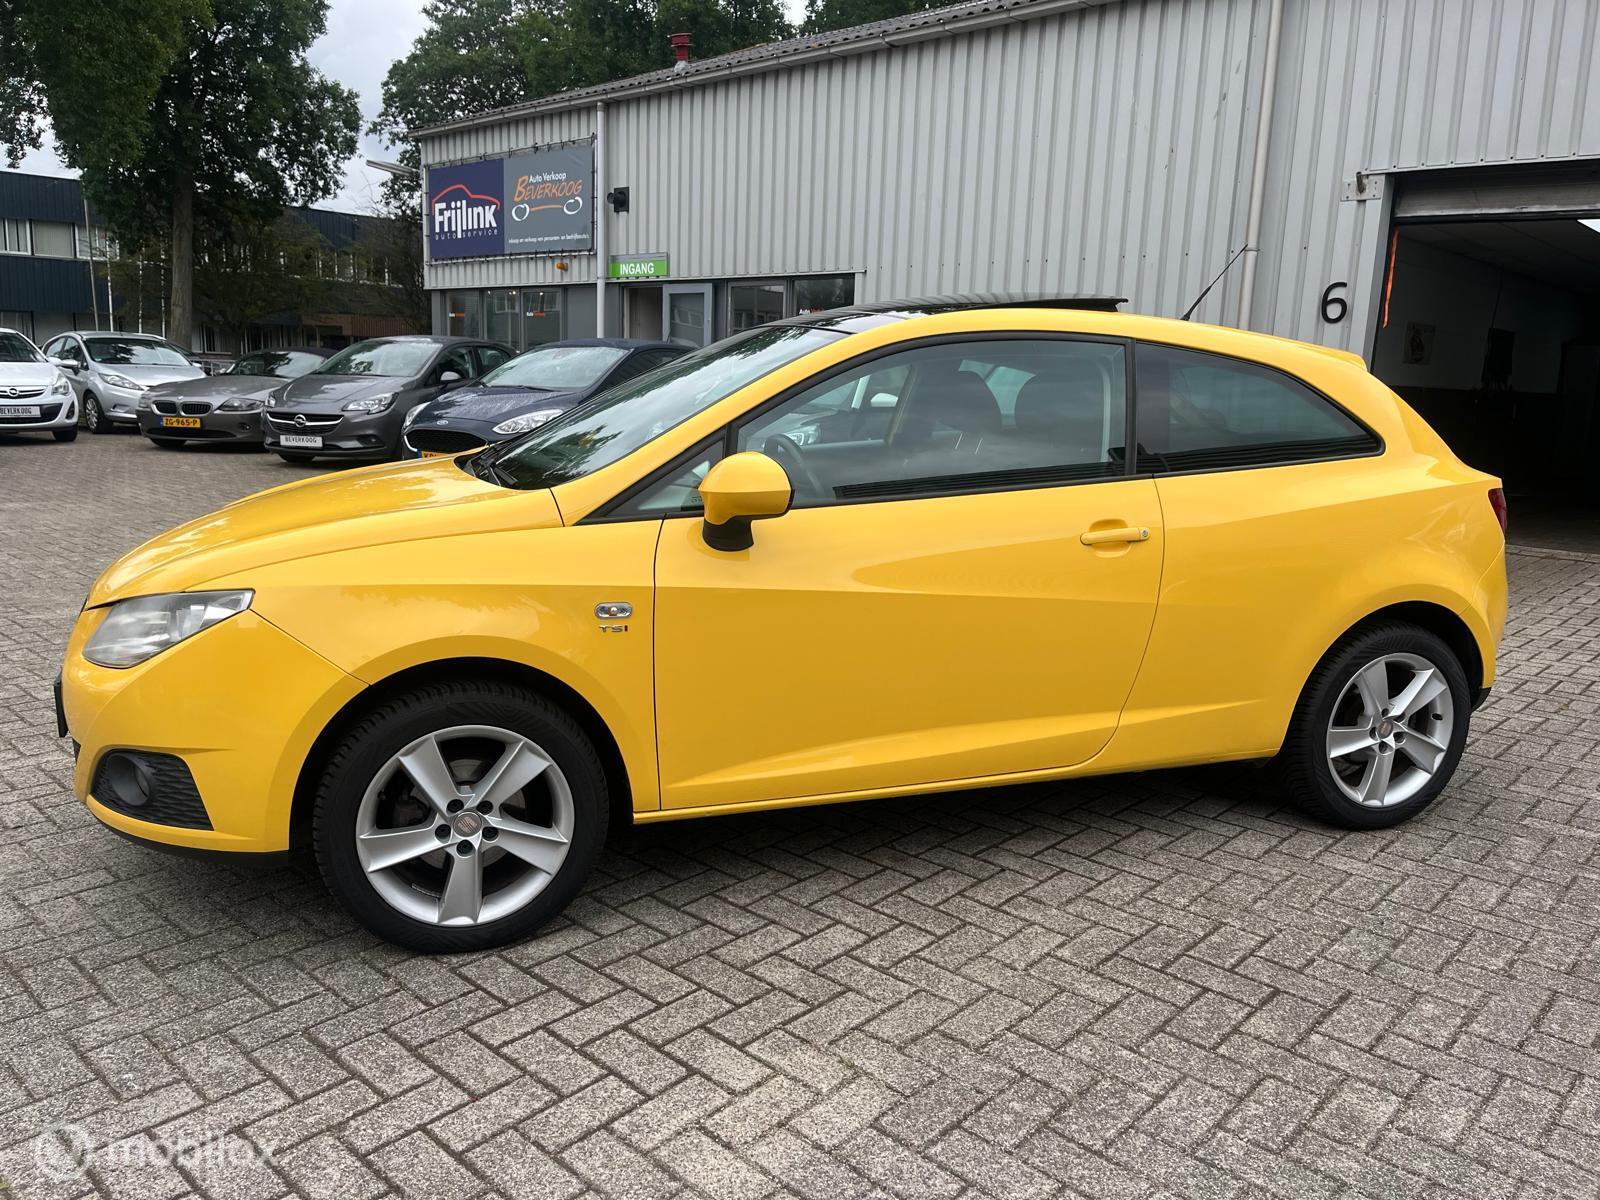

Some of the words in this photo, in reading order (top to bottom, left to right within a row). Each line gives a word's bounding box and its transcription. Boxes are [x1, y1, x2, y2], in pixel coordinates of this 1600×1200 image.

[529, 174, 543, 183] Auto
[543, 171, 567, 181] Verkoop
[513, 175, 583, 202] BEVERKOOG
[620, 262, 655, 275] INGANG
[1321, 281, 1348, 324] 6
[165, 418, 198, 426] ZG-965-P
[599, 624, 628, 633] TSI
